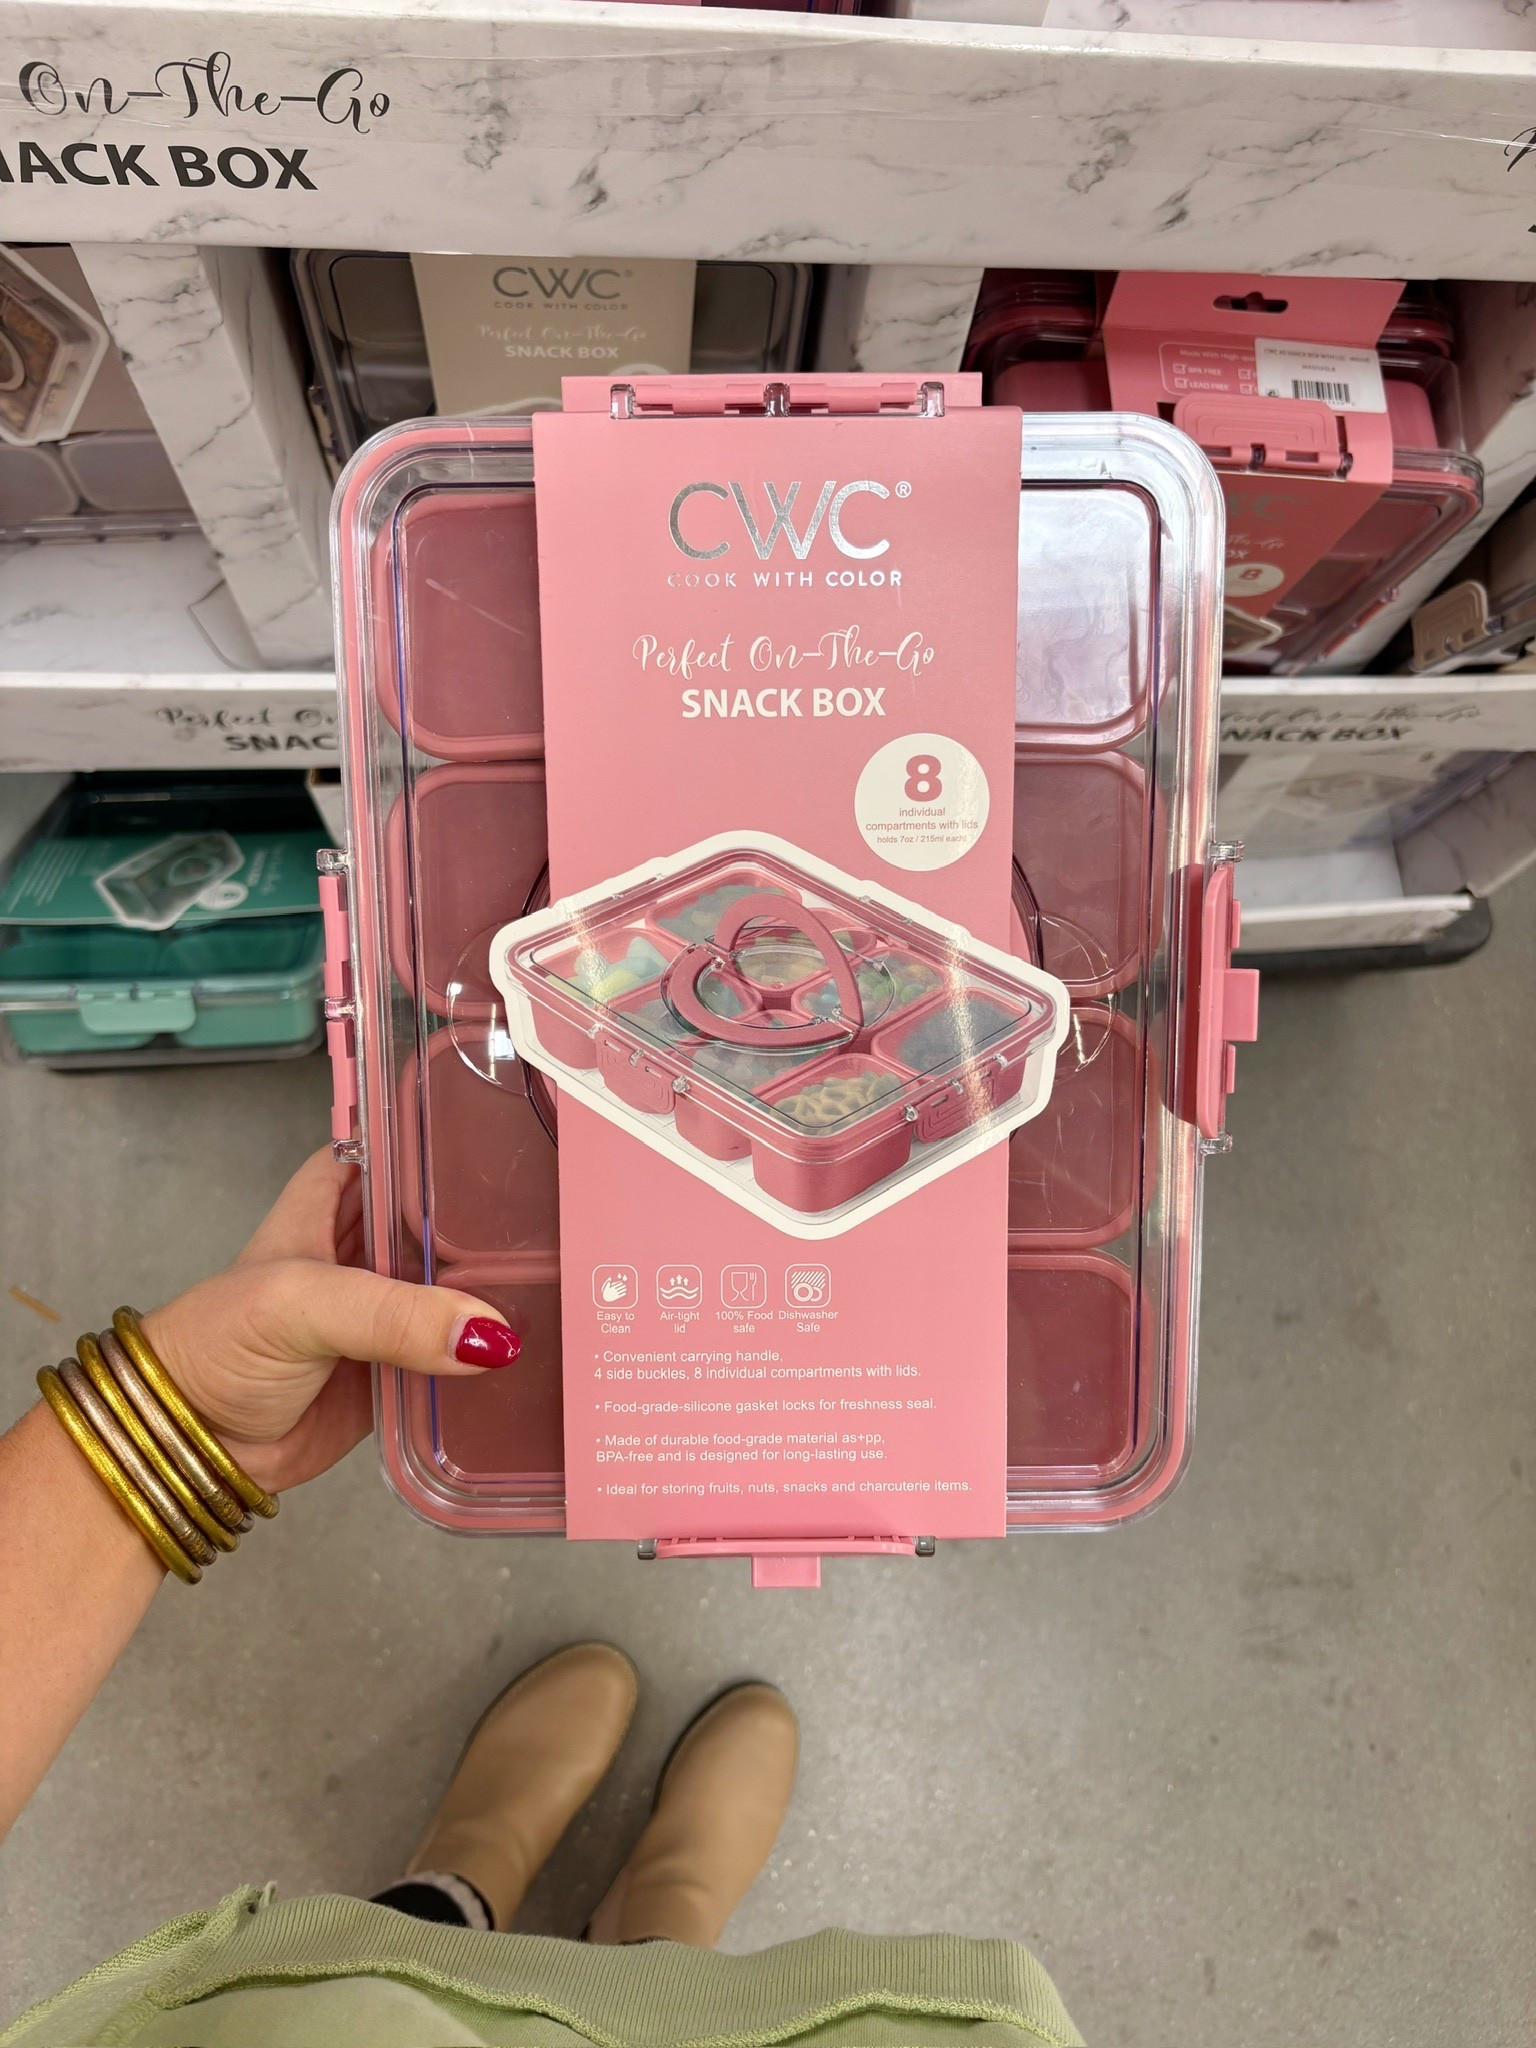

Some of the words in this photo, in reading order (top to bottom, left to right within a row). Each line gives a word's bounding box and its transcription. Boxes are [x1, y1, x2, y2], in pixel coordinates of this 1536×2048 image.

[18, 51, 390, 134] On-The-Go
[0, 141, 160, 187] ACK
[168, 146, 318, 190] BOX
[543, 302, 578, 310] WITH
[585, 303, 628, 311] COLOR
[505, 345, 573, 359] SNACK
[578, 346, 619, 359] BOX
[667, 572, 737, 588] COOK
[753, 571, 813, 587] WITH
[825, 570, 902, 587] COLOR
[632, 633, 735, 680] Perfect
[749, 625, 934, 676] On-The-Go
[681, 688, 803, 718] SNACK
[812, 687, 886, 717] BOX
[904, 754, 943, 802] 8
[899, 807, 945, 816] individual
[866, 821, 936, 832] compartments
[939, 819, 959, 829] with
[962, 819, 979, 828] lids
[920, 835, 943, 843] 215ml
[596, 1312, 622, 1323] Easy
[625, 1312, 635, 1321] to
[660, 1311, 700, 1323] Air-tight
[715, 1311, 744, 1321] 100%
[747, 1311, 774, 1320] Food
[778, 1310, 839, 1320] Dishwasher
[600, 1324, 631, 1334] Clean
[674, 1323, 686, 1333] lid
[733, 1323, 755, 1333] safe
[796, 1322, 820, 1333] Safe
[603, 1351, 676, 1363] Convenient
[680, 1352, 732, 1364] carrying
[594, 1368, 602, 1379] 4
[606, 1367, 633, 1380] side
[636, 1367, 690, 1381] buckles,
[694, 1367, 703, 1379] 8
[706, 1366, 767, 1379] individual
[771, 1366, 862, 1380] compartments
[866, 1365, 892, 1377] with
[896, 1365, 921, 1377] lids.
[604, 1400, 732, 1415] Food-grade-silicone
[735, 1400, 779, 1414] gasket
[782, 1399, 816, 1411] locks
[819, 1398, 837, 1410] for
[839, 1398, 903, 1410] freshness
[906, 1398, 937, 1409] seal.
[605, 1435, 641, 1446] Made
[644, 1434, 657, 1446] of
[660, 1434, 709, 1446] durable
[713, 1433, 783, 1447] food-grade
[786, 1432, 838, 1444] material
[596, 1450, 654, 1463] BPA-free
[657, 1450, 681, 1462] and
[685, 1450, 697, 1461] is
[699, 1449, 758, 1464] designed
[762, 1449, 780, 1461] for
[783, 1448, 857, 1463] long-lasting
[860, 1449, 887, 1460] use.
[606, 1484, 637, 1495] Ideal
[641, 1483, 659, 1495] for
[662, 1482, 705, 1497] storing
[708, 1482, 744, 1495] fruits,
[748, 1482, 779, 1494] nuts,
[783, 1481, 828, 1493] snacks
[831, 1480, 856, 1492] and
[859, 1480, 931, 1492] charcuterie
[934, 1480, 972, 1491] items.
